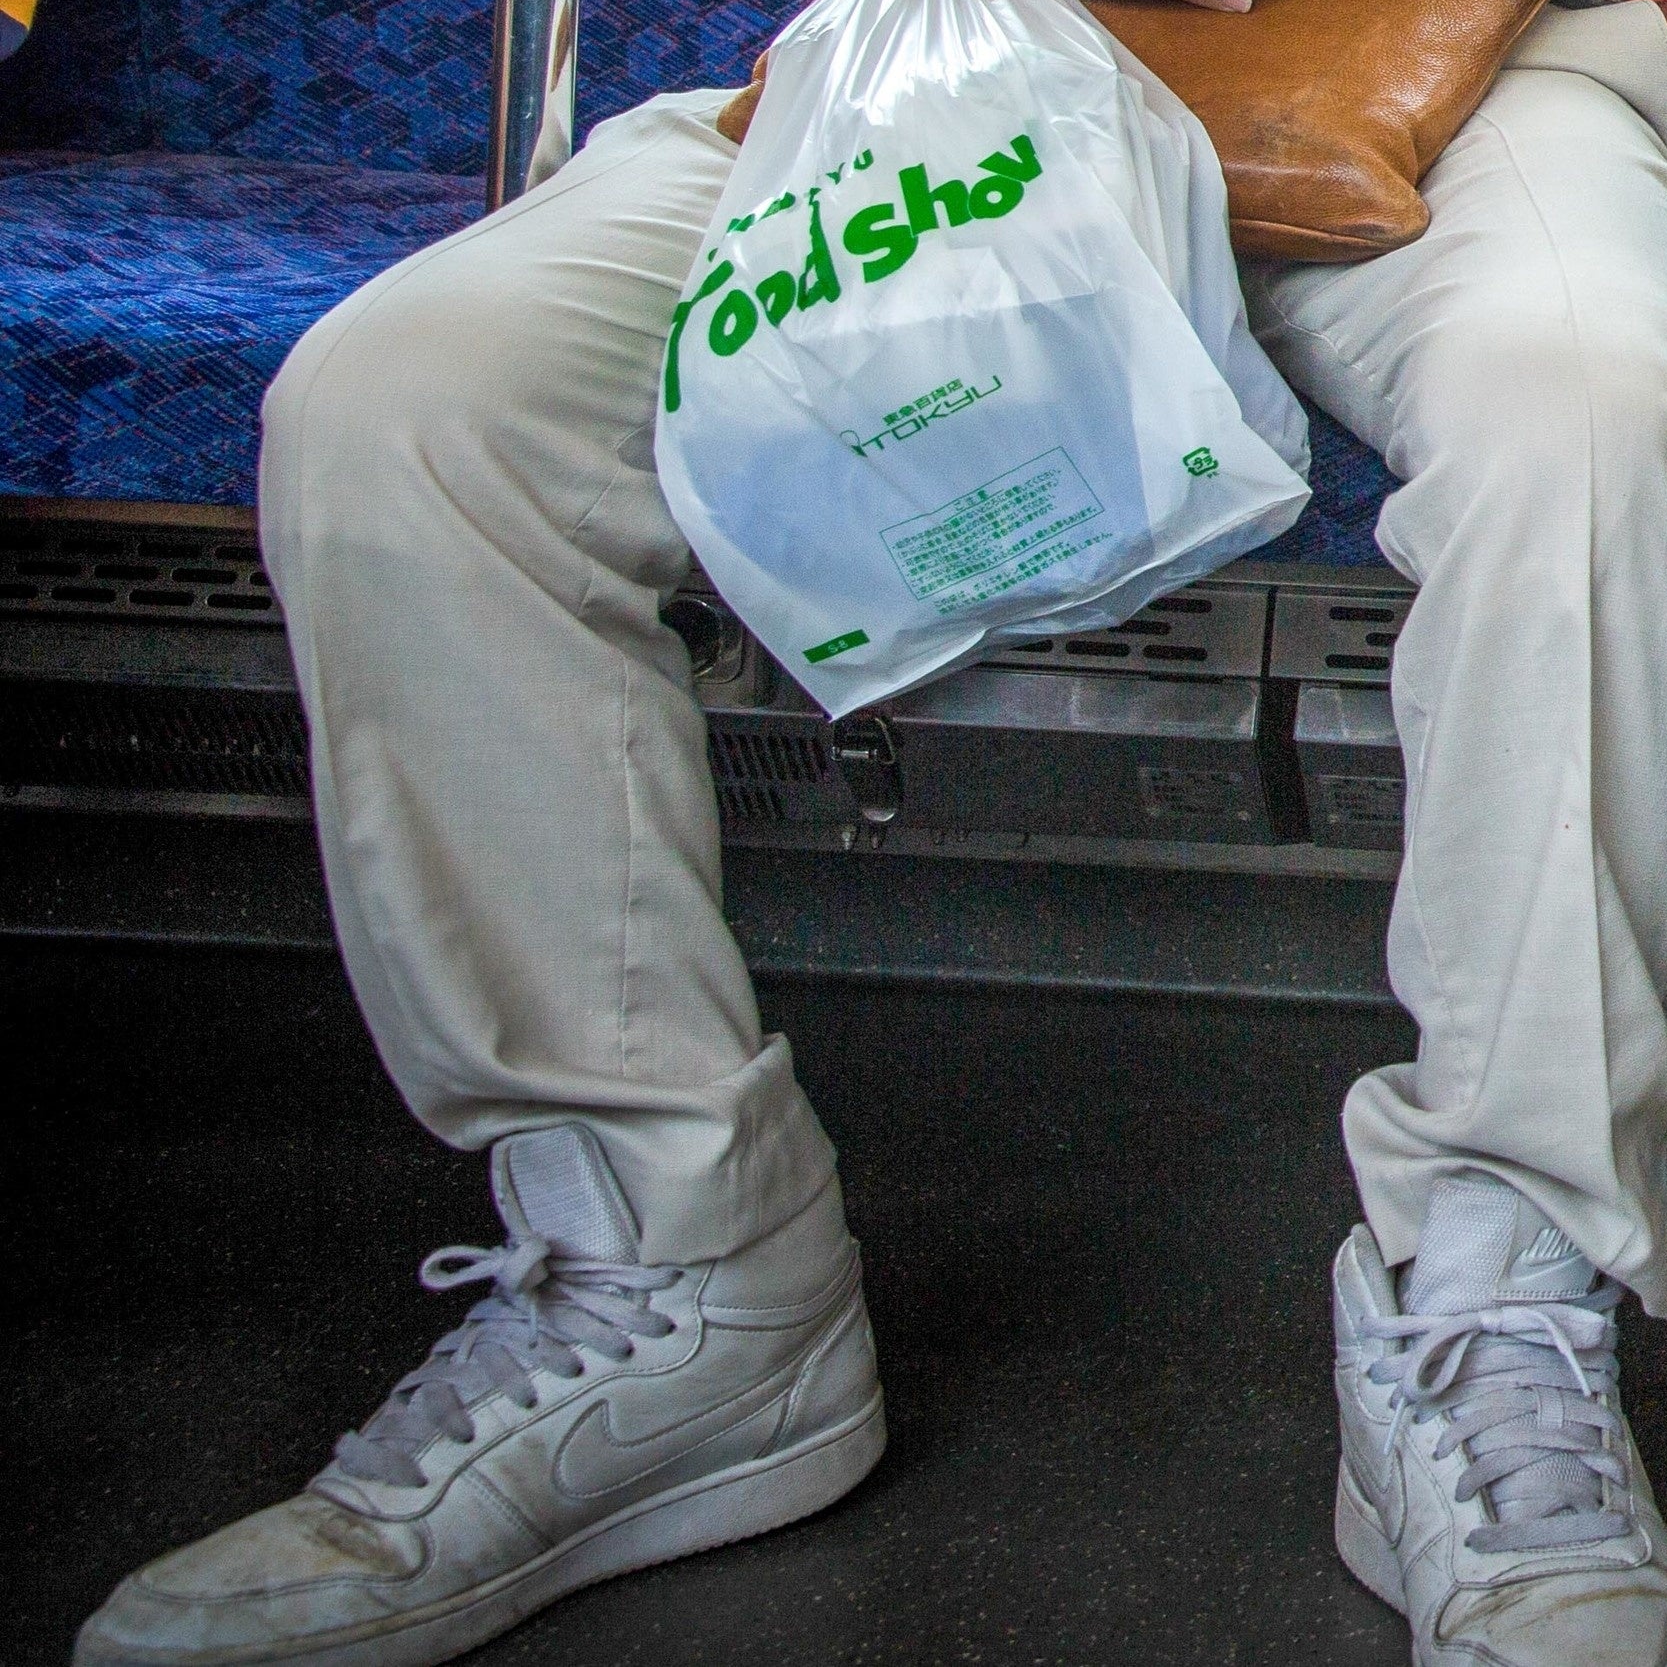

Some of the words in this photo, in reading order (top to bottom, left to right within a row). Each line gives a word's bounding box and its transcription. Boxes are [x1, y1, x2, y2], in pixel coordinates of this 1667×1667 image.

[861, 375, 1002, 451] TOKYU
[882, 377, 963, 426] 東急百貨店
